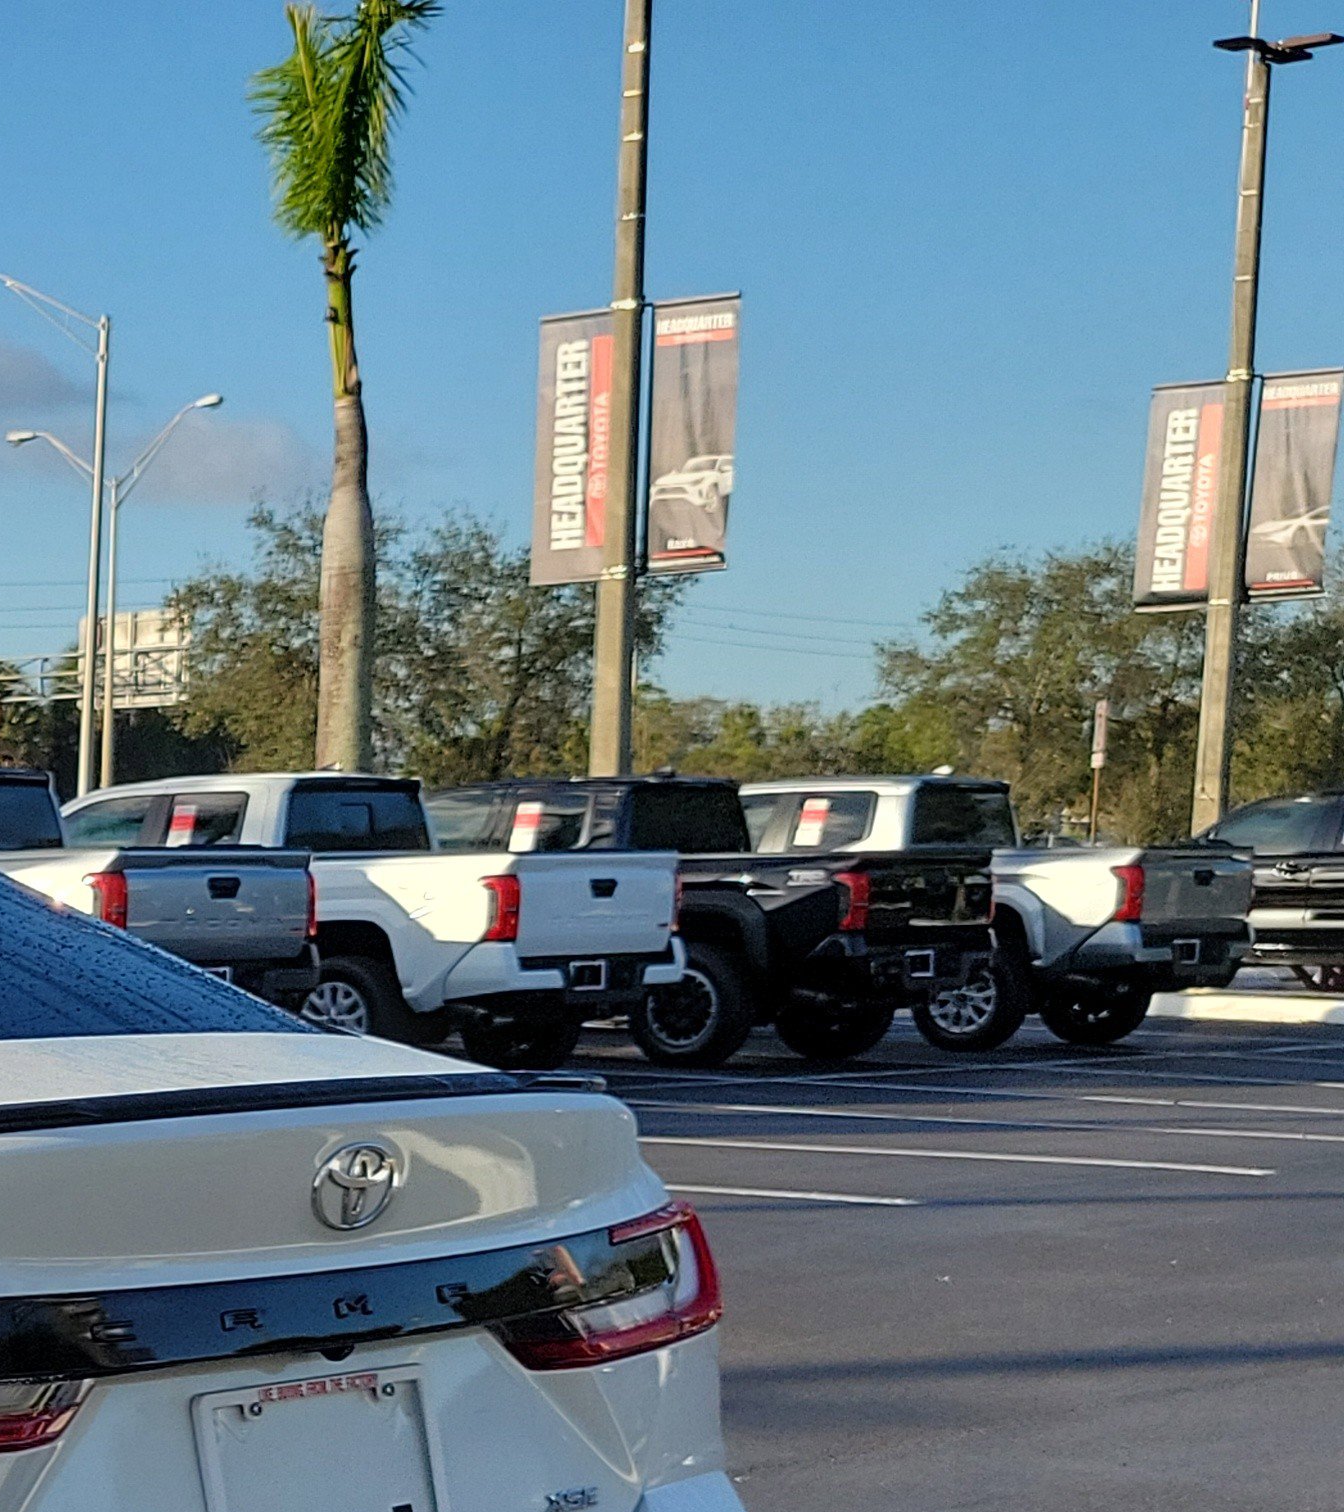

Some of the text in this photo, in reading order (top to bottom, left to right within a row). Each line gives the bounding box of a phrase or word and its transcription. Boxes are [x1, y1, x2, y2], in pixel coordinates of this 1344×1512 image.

[550, 339, 589, 550] HEADQUARTER
[590, 392, 610, 471] TOYOTA
[1193, 453, 1215, 522] TOYOTA
[1150, 407, 1198, 591] HEADQUARTER
